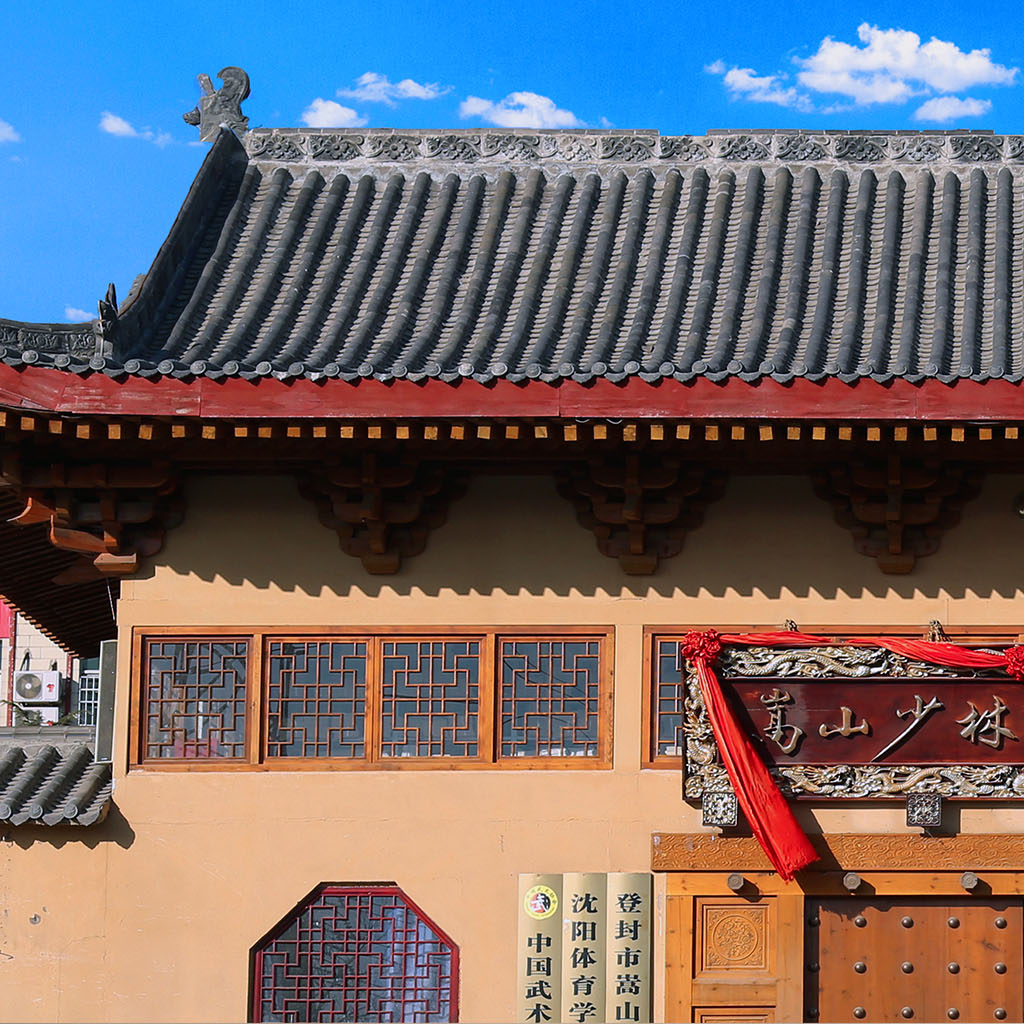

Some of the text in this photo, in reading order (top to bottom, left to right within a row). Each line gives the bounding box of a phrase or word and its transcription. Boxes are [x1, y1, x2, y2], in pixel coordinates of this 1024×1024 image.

[525, 933, 552, 1023] 中国武术
[569, 893, 598, 1023] 沈阳体育学
[614, 892, 642, 1022] 登封市嵩山
